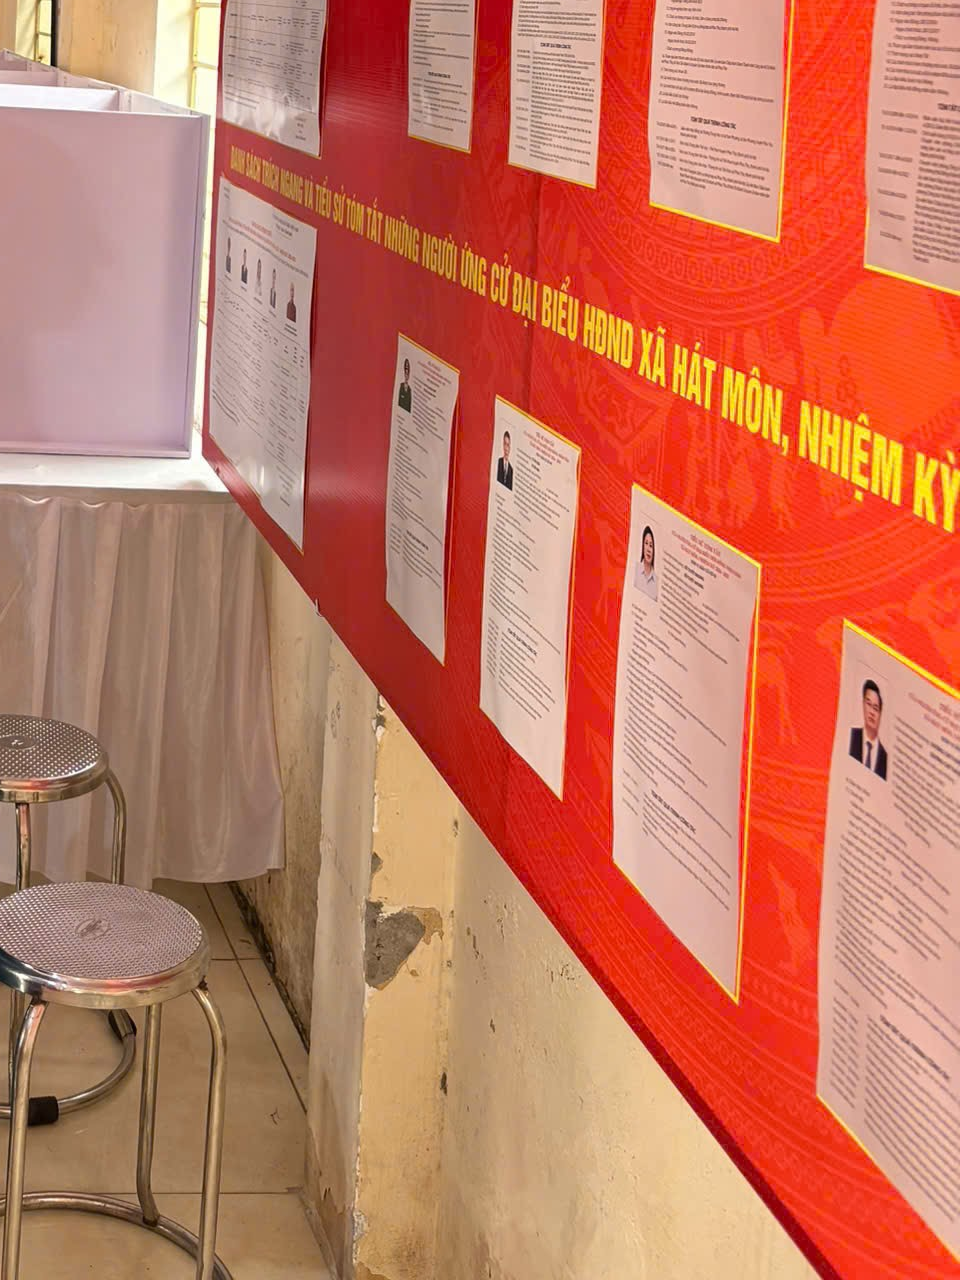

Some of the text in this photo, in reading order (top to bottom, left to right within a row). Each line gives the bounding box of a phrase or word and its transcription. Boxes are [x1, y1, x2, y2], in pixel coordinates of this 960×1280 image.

[230, 145, 960, 533] DANH SÁCH TRÍCH NGANG VÀ TIỂU SỬ TÓM TẮT NHỮNG NGƯỜI ỨNG CỬ ĐẠI BIỂU HĐND XÃ HÁT MÔN, NHIỆM KỲ
